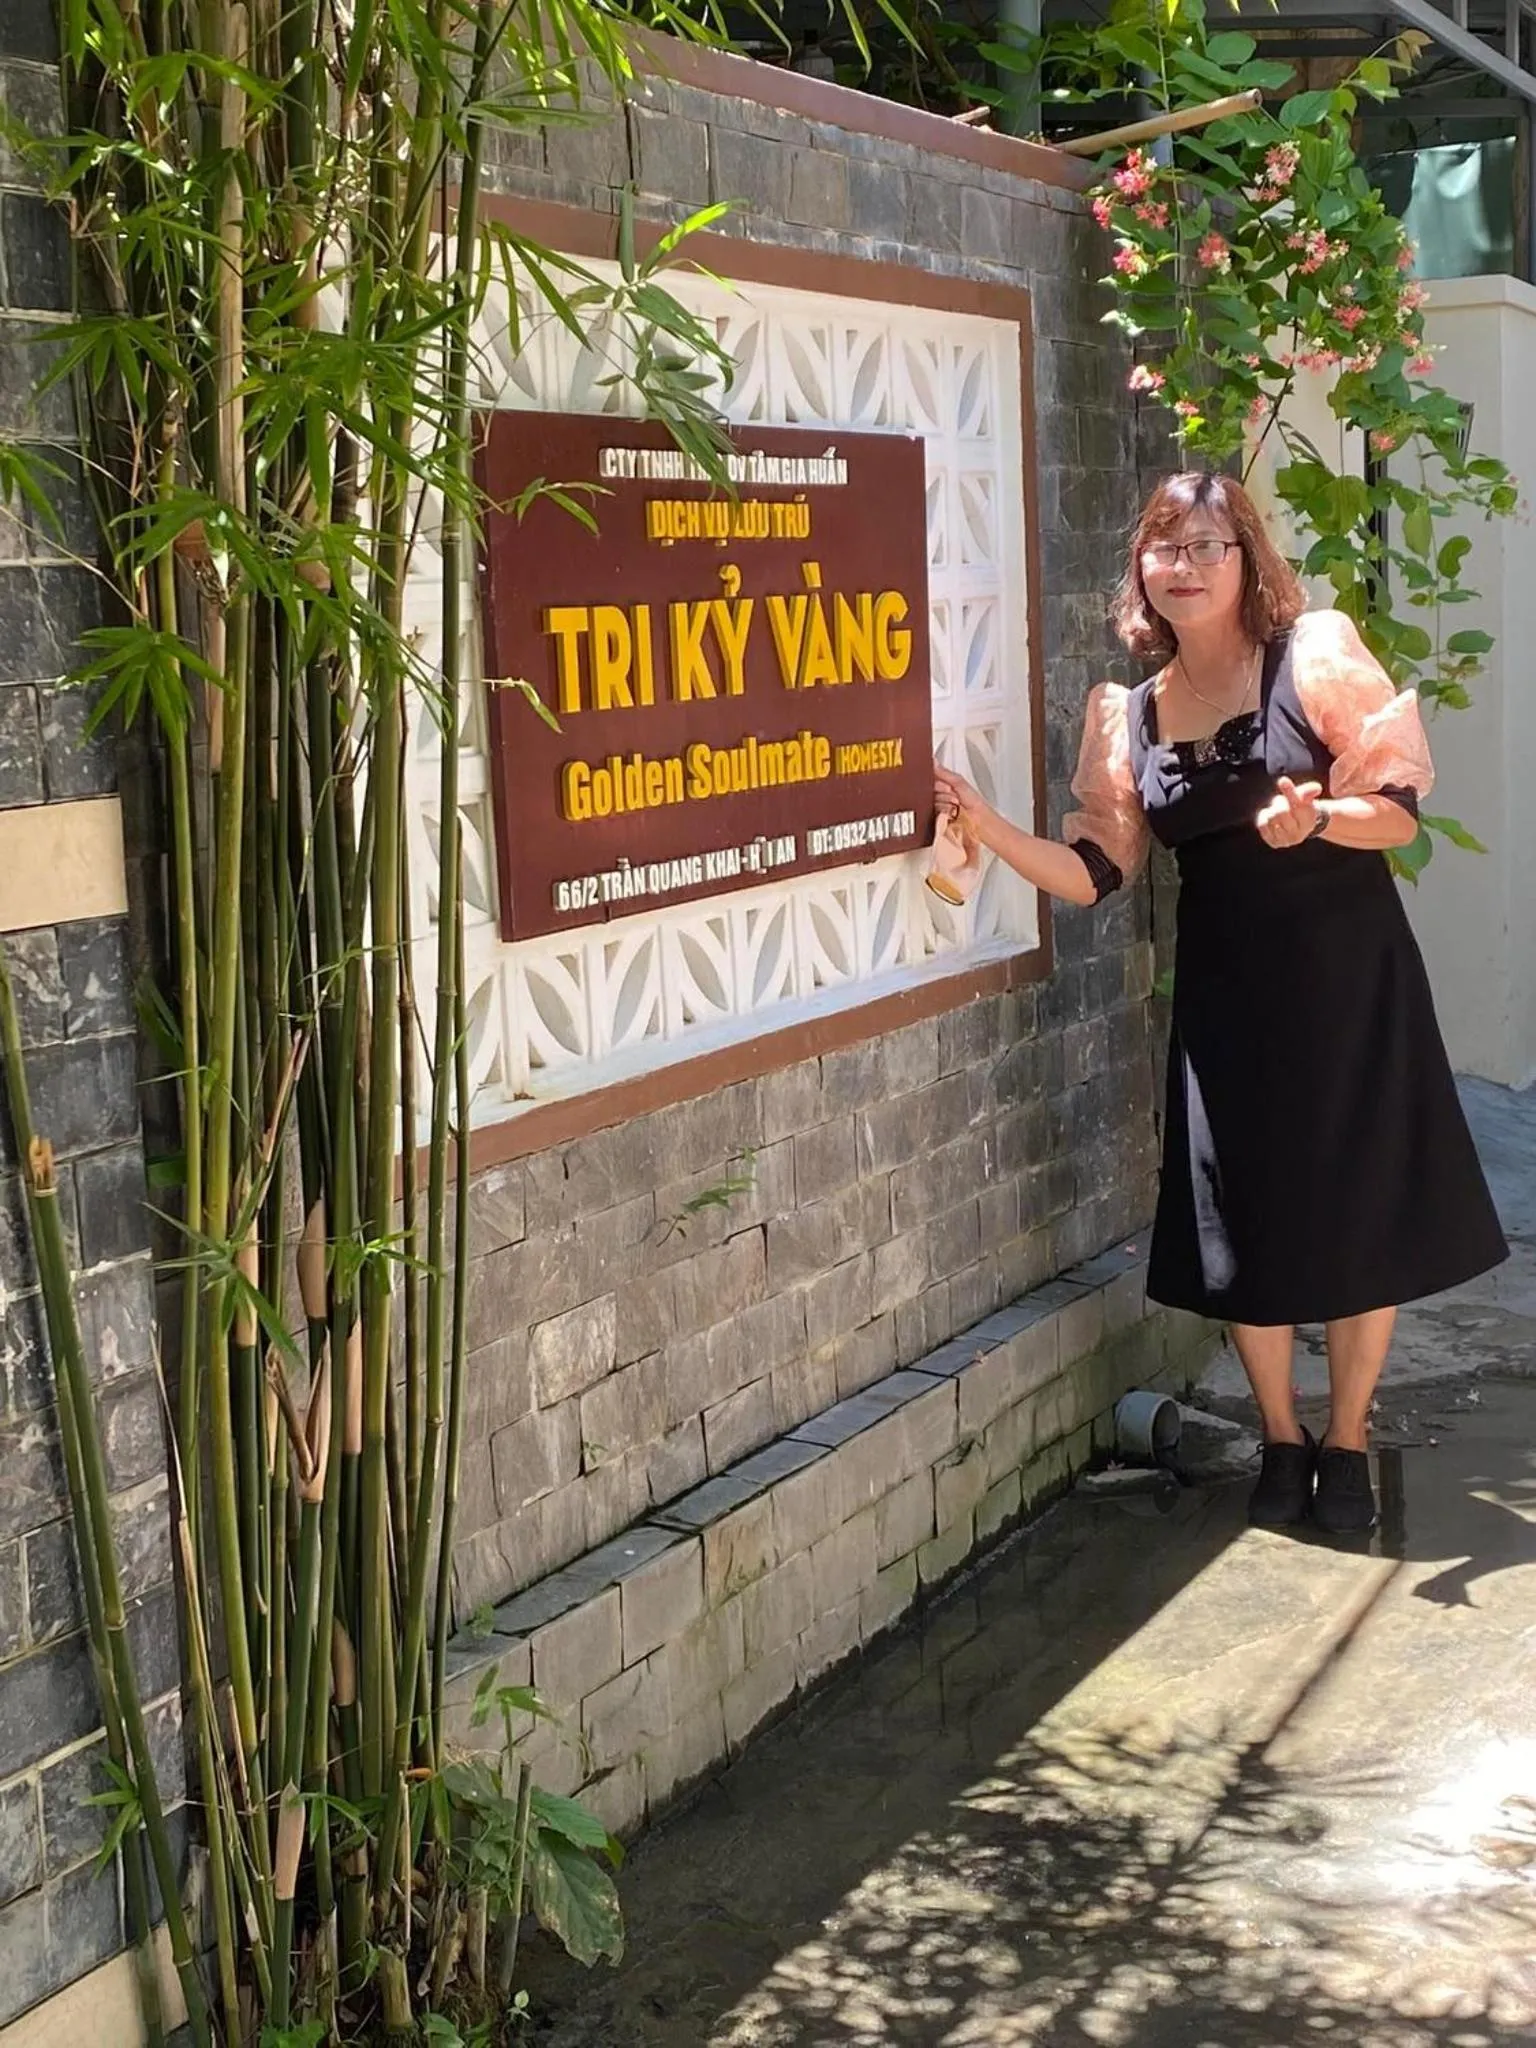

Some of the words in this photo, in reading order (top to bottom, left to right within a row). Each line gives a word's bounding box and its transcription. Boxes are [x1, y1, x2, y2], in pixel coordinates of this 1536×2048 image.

[600, 447, 636, 478] CTY
[638, 449, 684, 479] TNHH
[781, 457, 807, 484] GIA
[648, 500, 700, 546] DỊCH
[703, 501, 729, 546] VỤ
[544, 604, 655, 713] TRI
[669, 564, 754, 702] KỶ
[766, 561, 912, 690] VÀNG
[564, 753, 685, 821] Golden
[687, 730, 831, 800] Soulmate
[554, 876, 599, 911] 66/2
[648, 856, 702, 894] QUANG
[776, 835, 796, 865] AN
